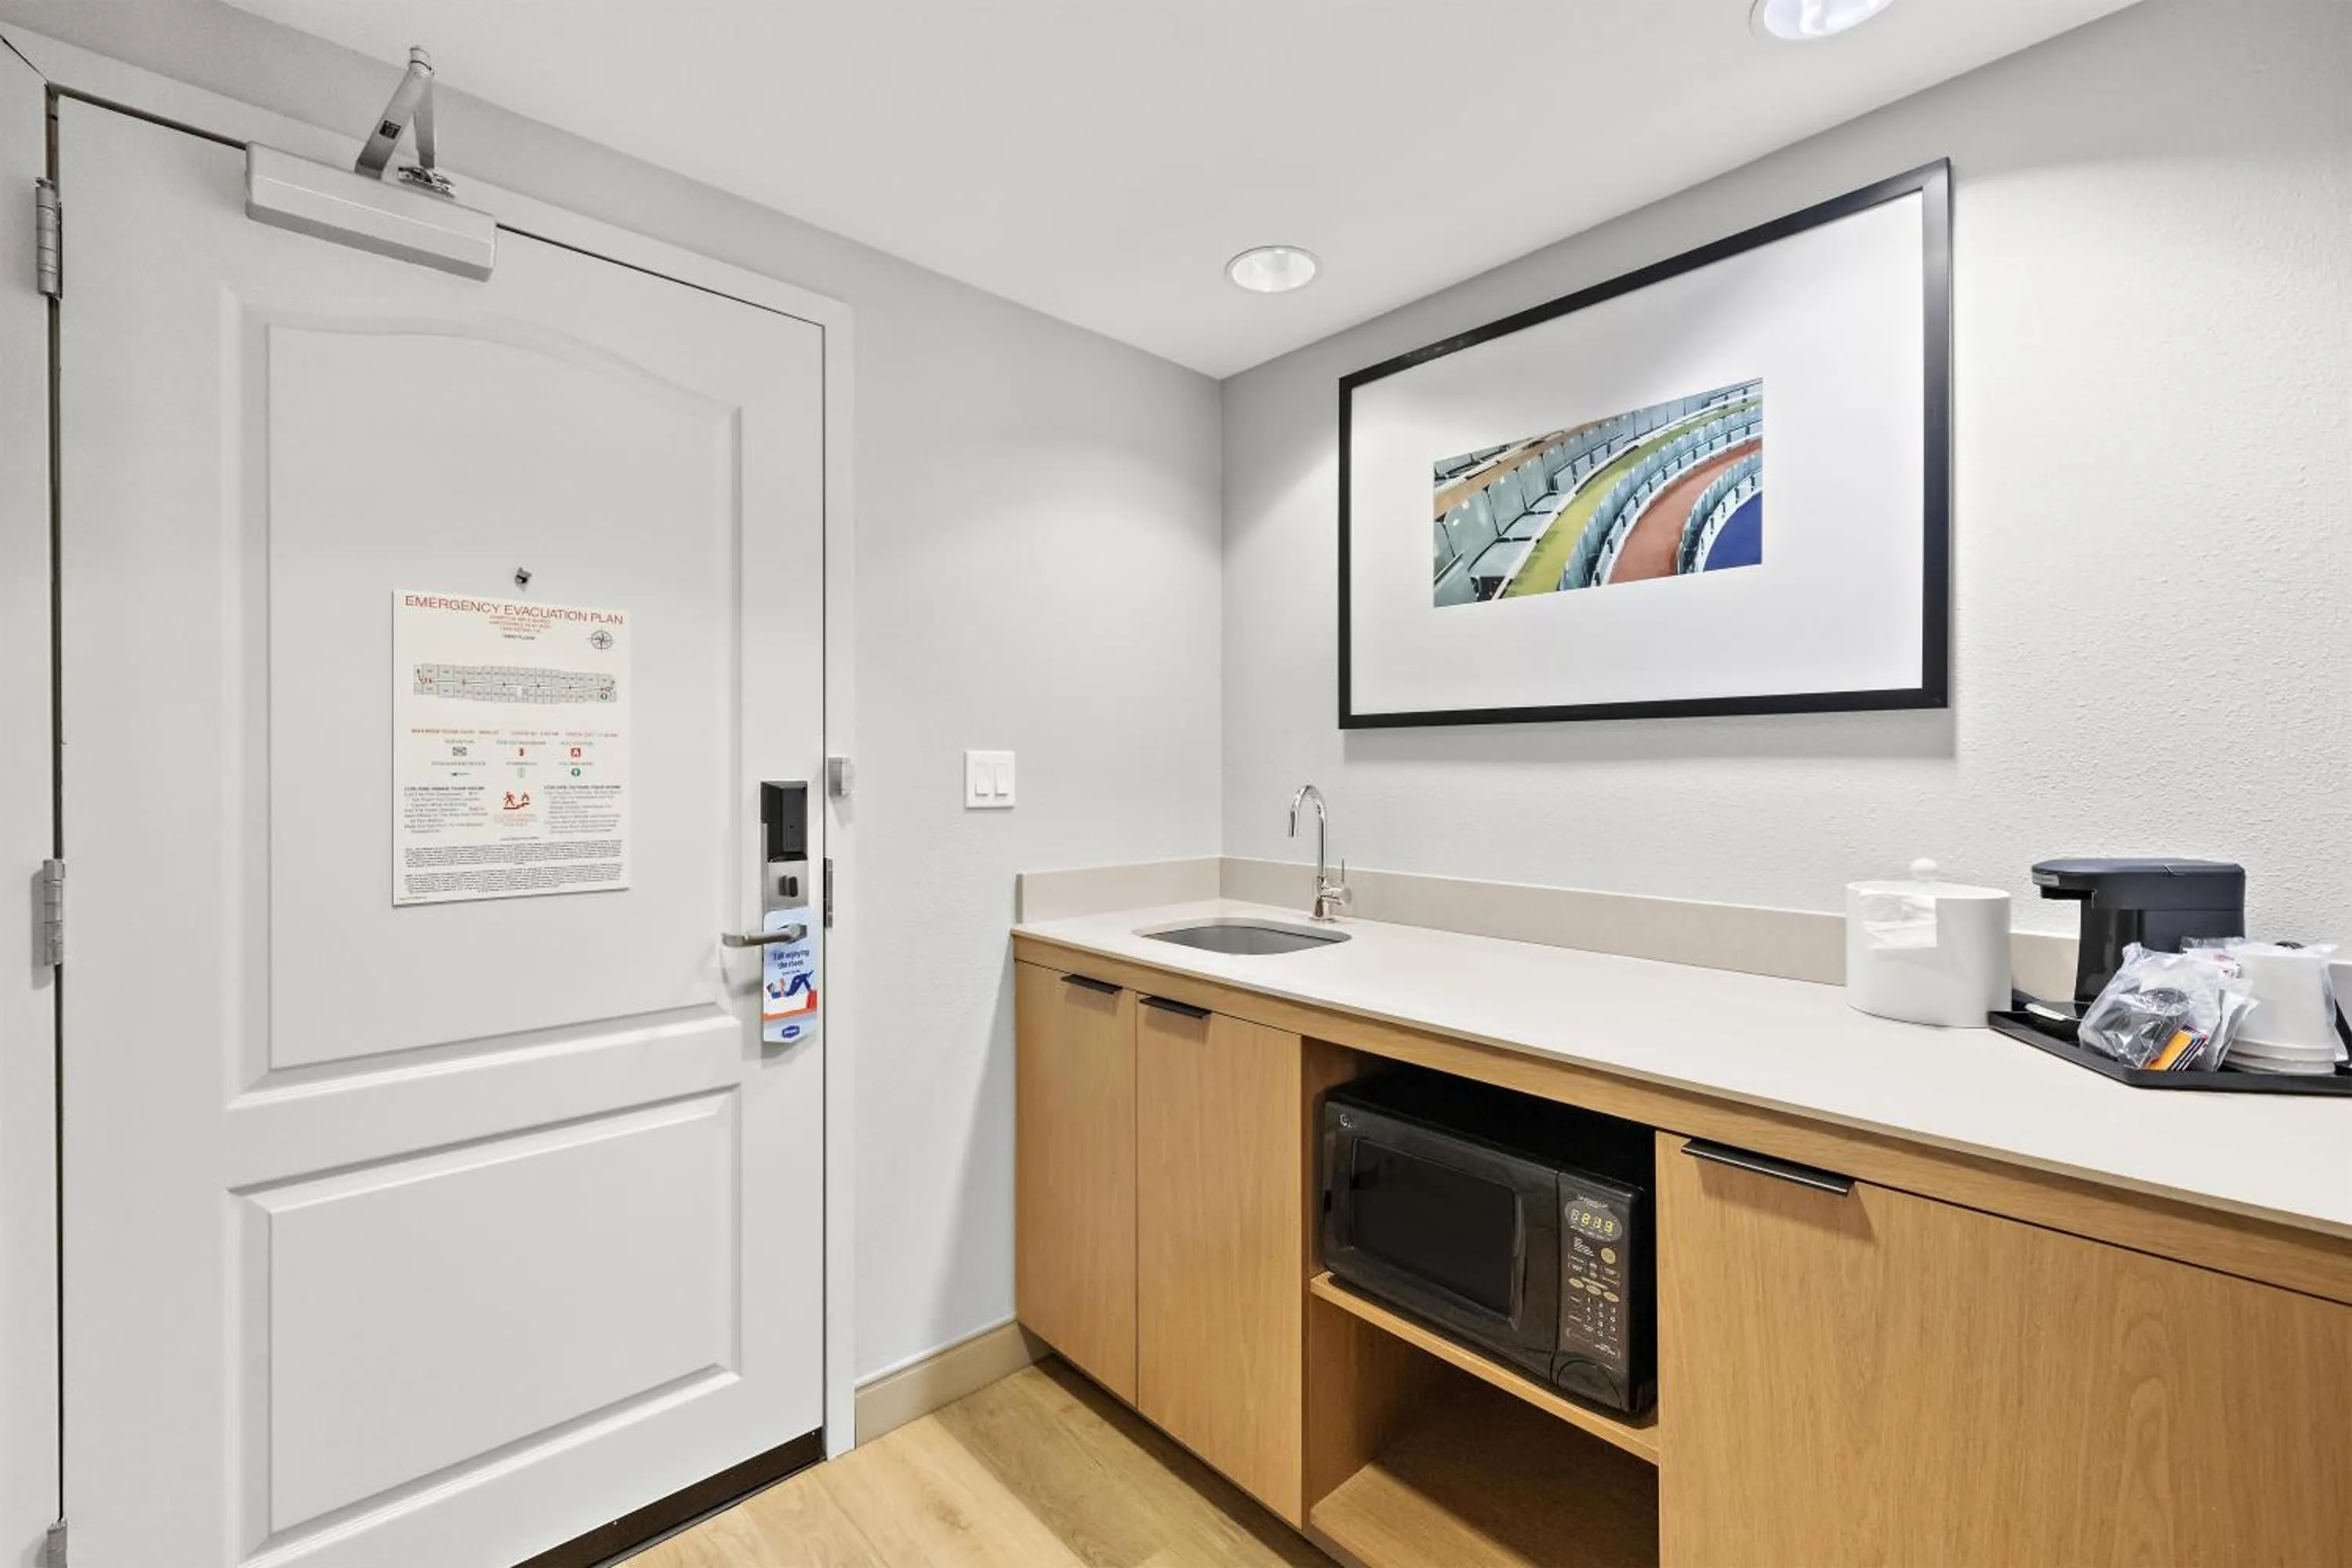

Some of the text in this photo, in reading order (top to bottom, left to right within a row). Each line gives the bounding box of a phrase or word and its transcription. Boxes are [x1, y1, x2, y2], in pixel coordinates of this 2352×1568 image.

[405, 595, 624, 625] EMERGENCY EVACUATION PLAN
